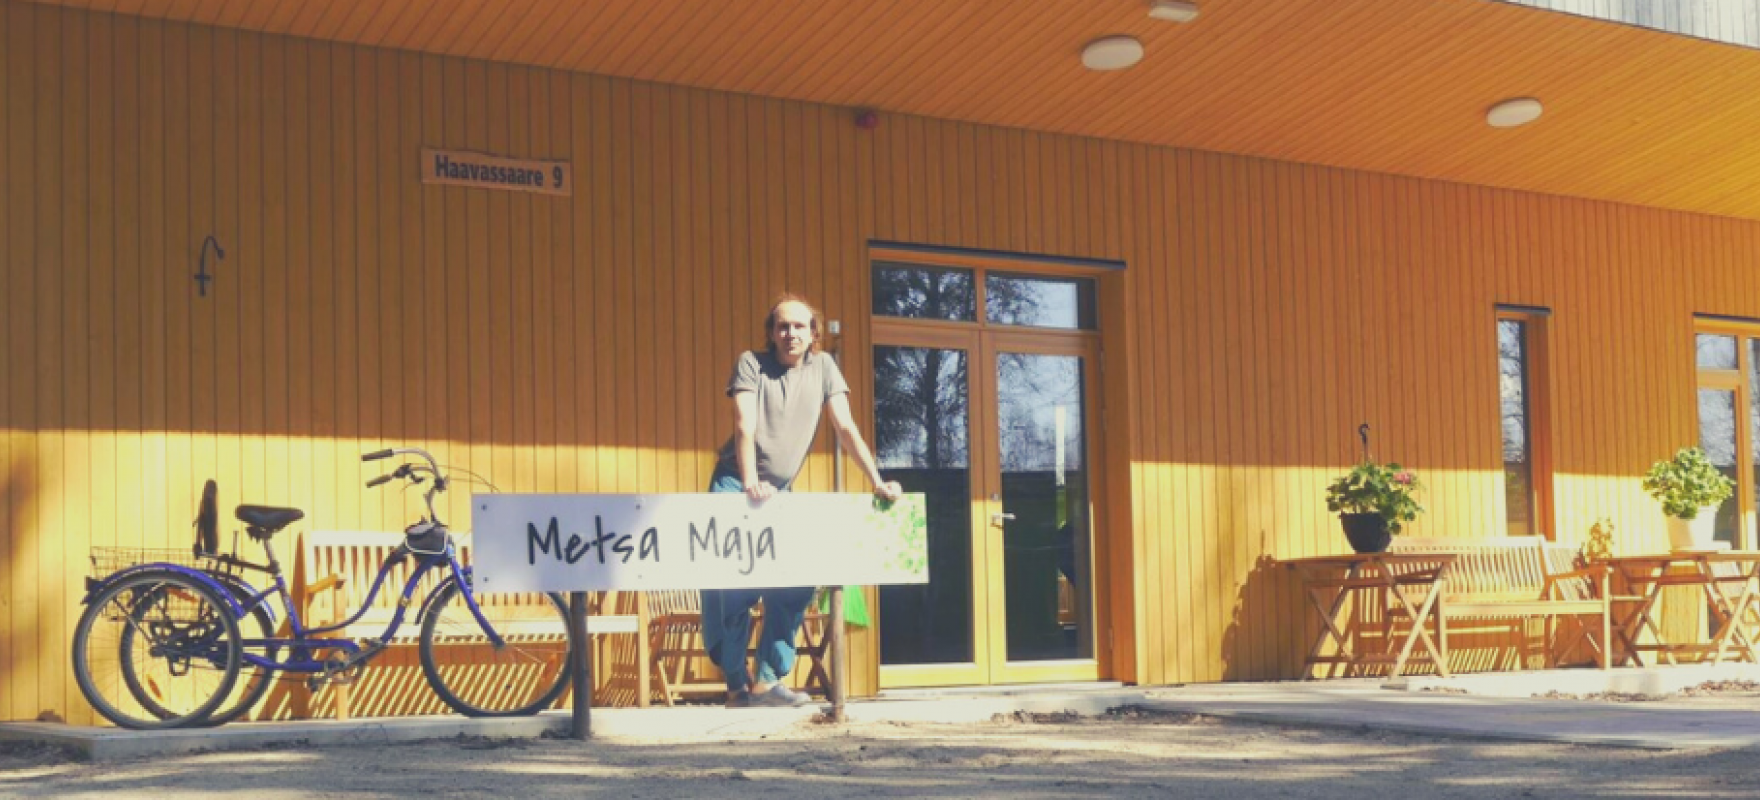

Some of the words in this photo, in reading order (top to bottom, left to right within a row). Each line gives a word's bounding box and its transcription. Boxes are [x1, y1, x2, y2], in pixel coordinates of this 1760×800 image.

[435, 154, 544, 187] Haavassaare
[552, 165, 563, 188] 9
[526, 515, 660, 566] Metsa
[688, 515, 777, 575] Maja
